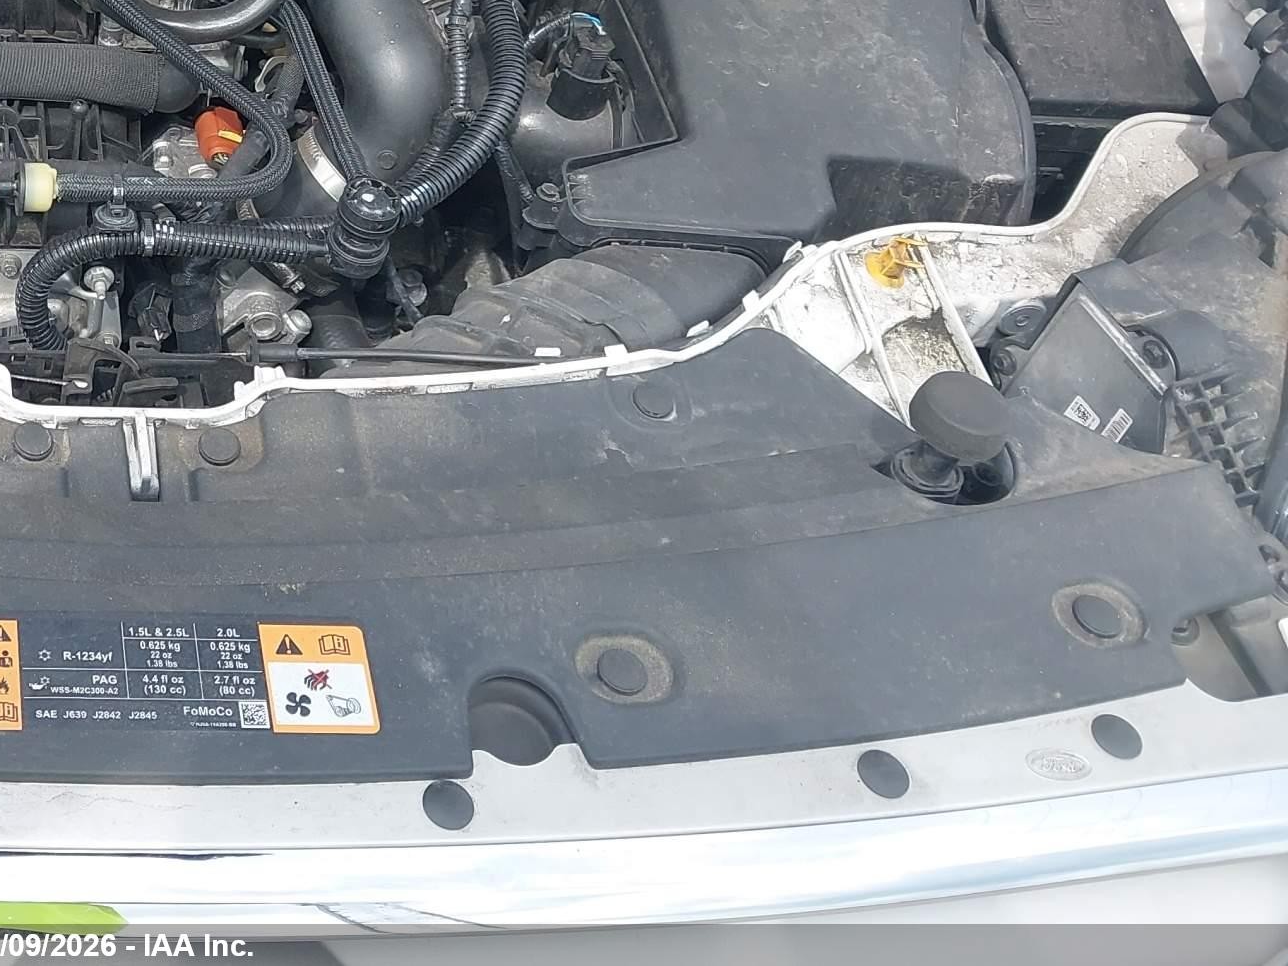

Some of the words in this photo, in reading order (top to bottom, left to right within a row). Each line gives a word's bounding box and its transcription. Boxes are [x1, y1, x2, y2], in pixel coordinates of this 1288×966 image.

[128, 627, 152, 637] 1.5L
[154, 627, 163, 637] &
[165, 628, 190, 638] 2.5L
[216, 628, 241, 638] 2.0L
[140, 640, 166, 651] 0.625
[168, 641, 181, 652] kg
[210, 641, 236, 652] 0.625
[238, 642, 251, 653] kg
[63, 650, 113, 663] R-1234yf
[150, 651, 161, 660] 22
[162, 652, 173, 660] oz
[220, 652, 232, 661] 22
[232, 653, 243, 661] oz
[146, 659, 164, 668] 1.38
[165, 660, 178, 669] lbs
[217, 660, 235, 670] 1.38
[235, 661, 249, 670] lbs
[92, 674, 118, 685] PAG
[142, 674, 159, 684] 4.4
[161, 674, 169, 684] fl
[171, 675, 184, 684] oz
[214, 675, 230, 685] 2.7
[232, 675, 240, 685] fl
[242, 677, 256, 686] oz
[144, 684, 166, 696] (130
[169, 684, 187, 696] cc)
[219, 685, 236, 697] (80
[238, 685, 255, 697] cc)
[35, 709, 58, 719] SAE
[62, 710, 88, 720] J639
[92, 710, 122, 720] J2842
[128, 711, 158, 721] J2845
[183, 706, 233, 717] FoMoCo
